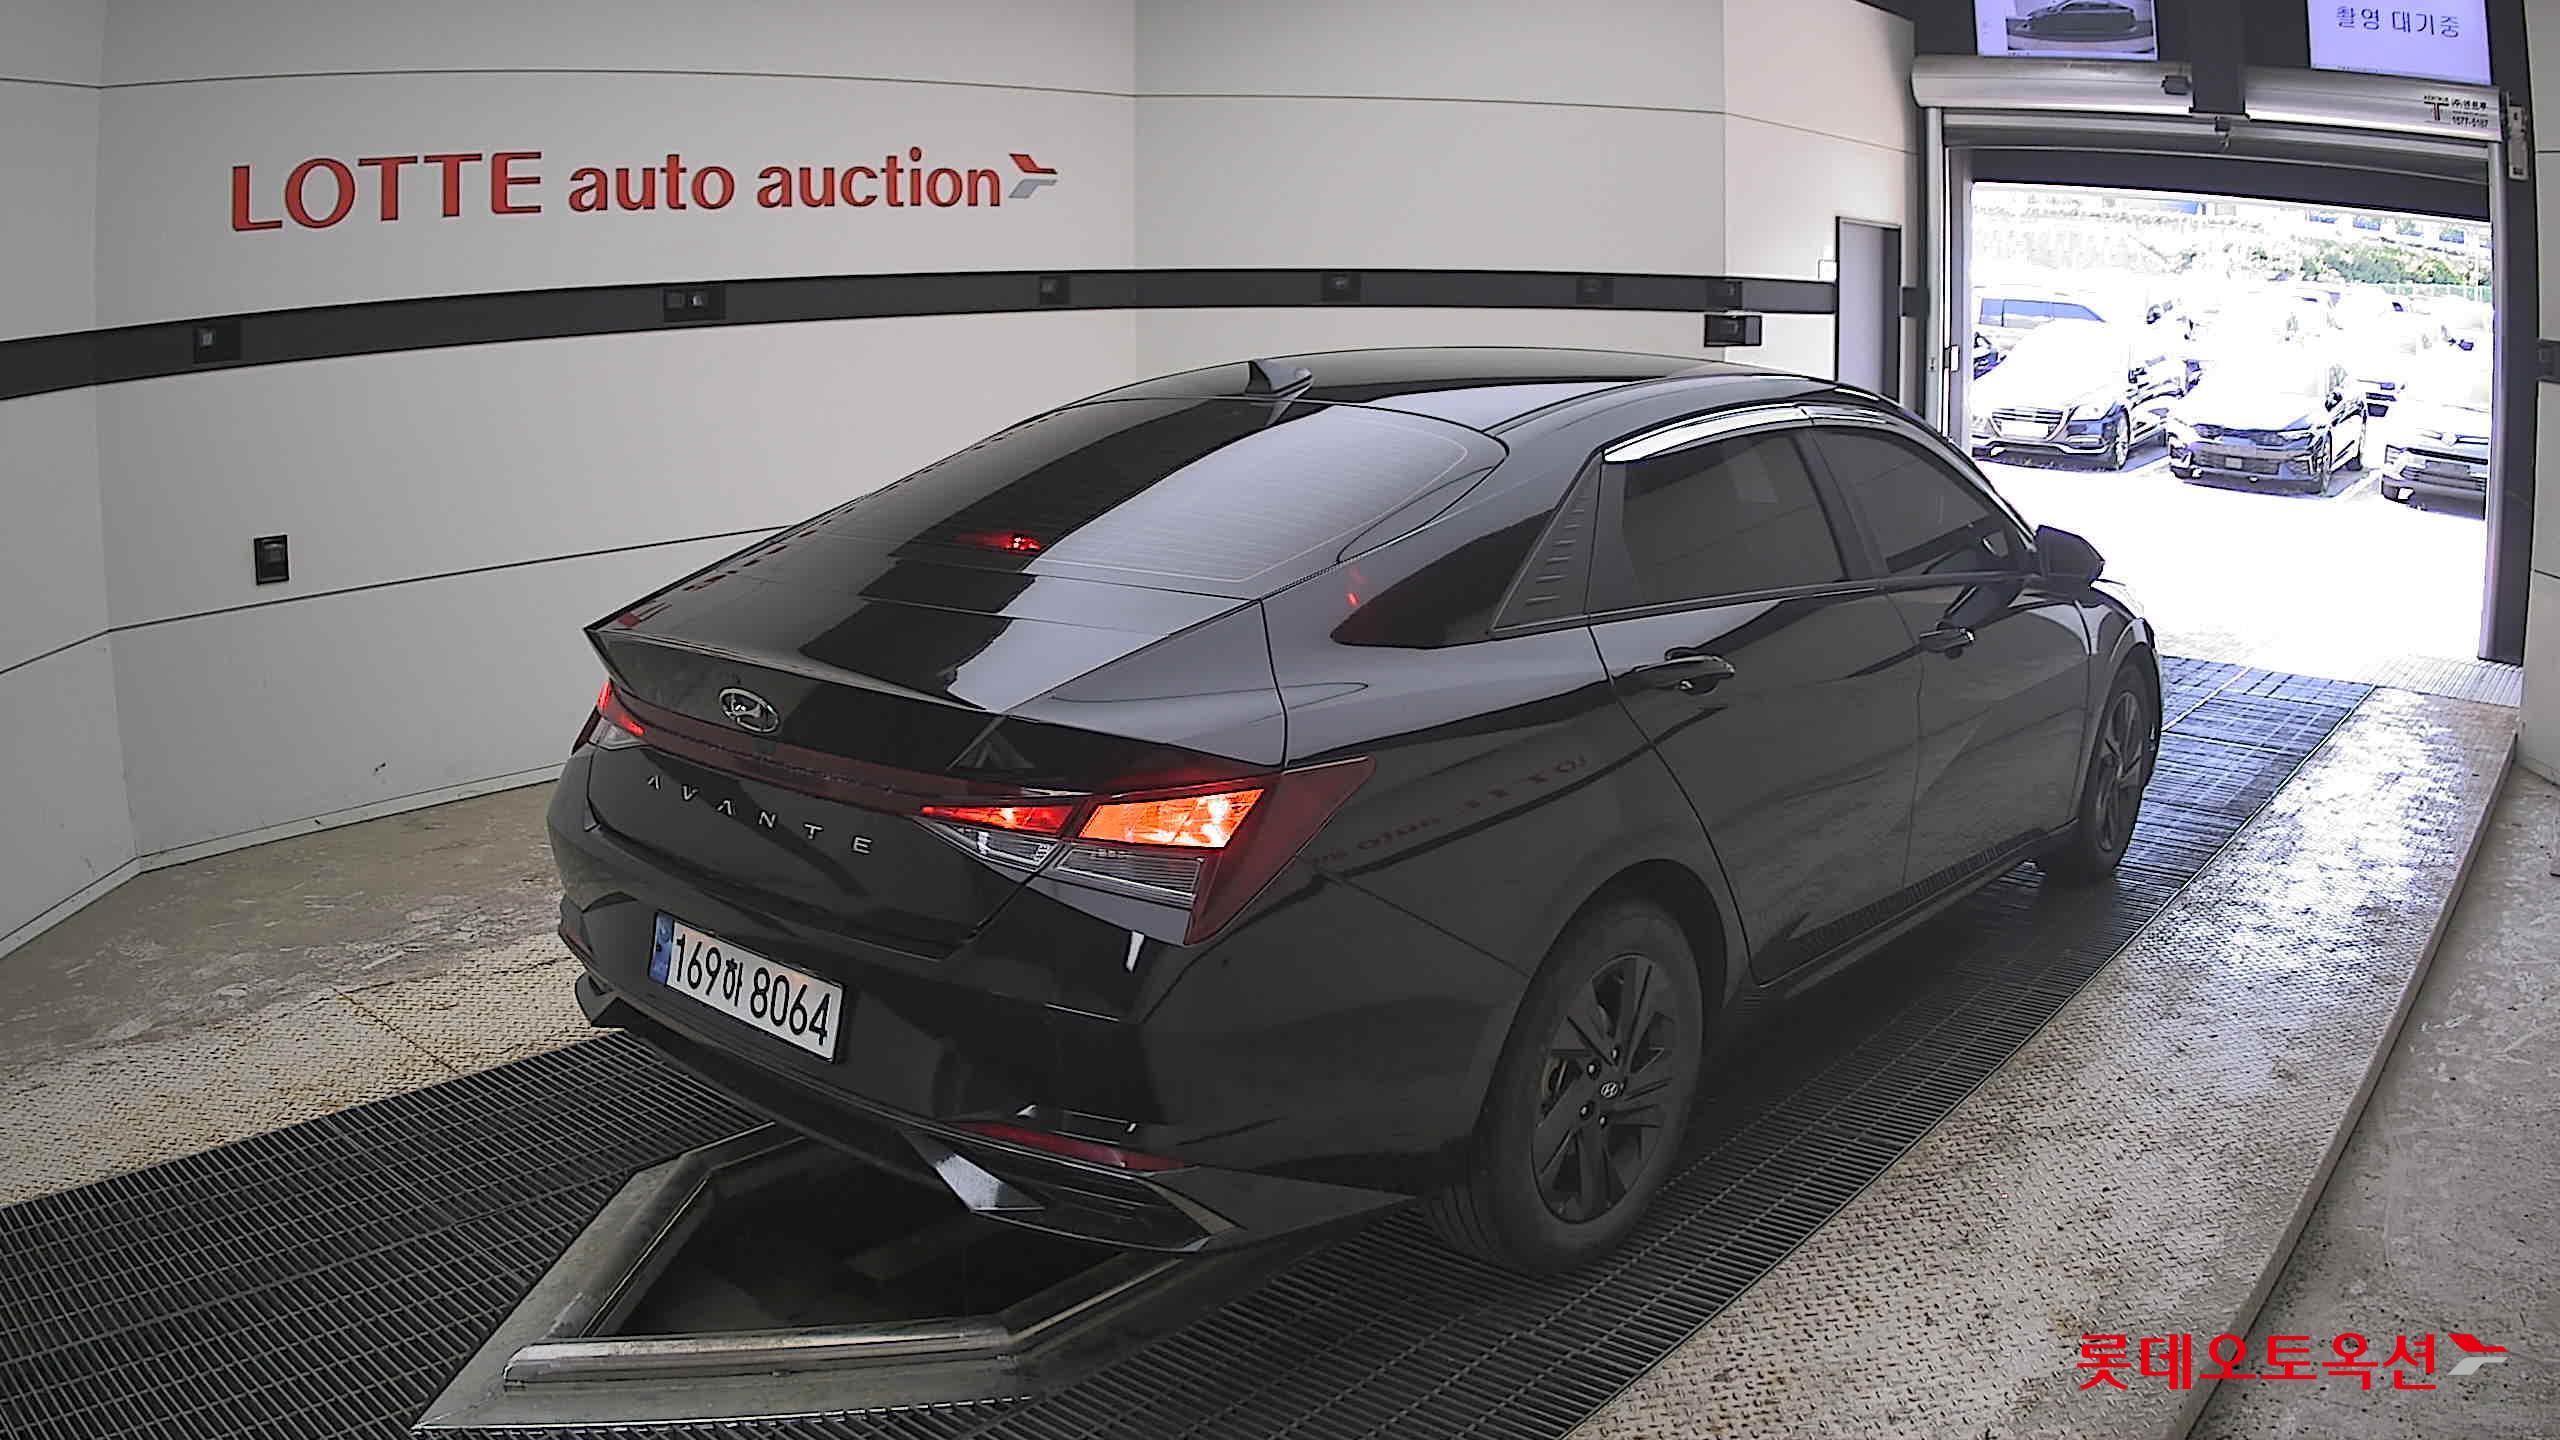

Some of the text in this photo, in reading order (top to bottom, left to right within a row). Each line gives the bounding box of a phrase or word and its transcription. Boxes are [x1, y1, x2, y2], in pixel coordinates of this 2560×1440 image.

[2336, 6, 2460, 38] 촬영 대기중
[231, 146, 1002, 232] LOTTE auto auction
[648, 774, 872, 855] AVANTE
[675, 933, 832, 1047] 169하 8064
